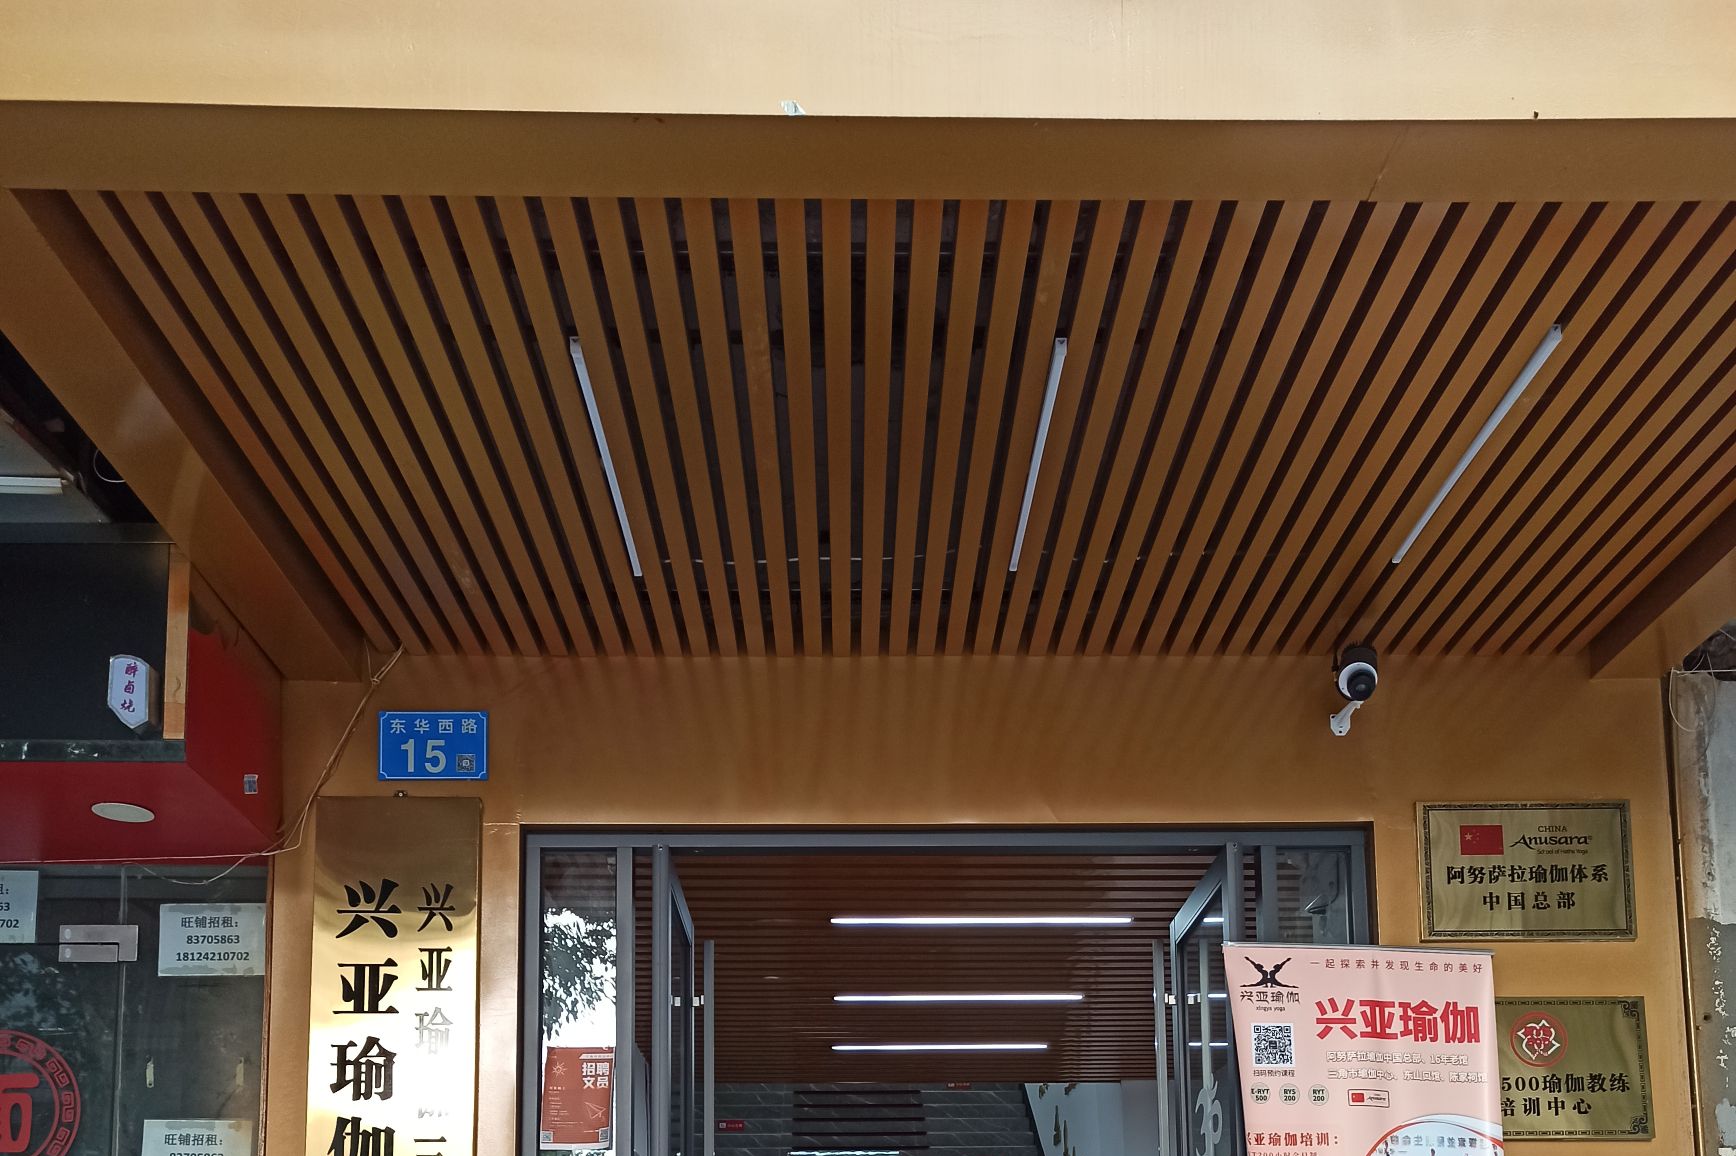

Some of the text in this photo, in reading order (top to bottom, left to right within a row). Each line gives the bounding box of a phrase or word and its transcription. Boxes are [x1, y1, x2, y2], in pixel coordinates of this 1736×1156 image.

[390, 719, 478, 734] 东华西路
[401, 739, 447, 773] 15
[1537, 825, 1568, 833] CHINA
[1446, 863, 1609, 885] 阿努萨拉瑜伽体系
[1483, 891, 1576, 911] 中国总部
[186, 933, 240, 944] 83705863
[175, 950, 250, 961] 18124210702
[1310, 958, 1483, 974] 一起探索并发现生命的美好
[1240, 990, 1300, 1004] 兴亚瑜伽
[1315, 997, 1481, 1043] 兴亚瑜伽
[582, 1062, 610, 1075] 招聘
[1253, 1069, 1296, 1077] 扫码预约课程
[583, 1077, 609, 1089] 文员
[1502, 1072, 1631, 1094] 500瑜伽教练
